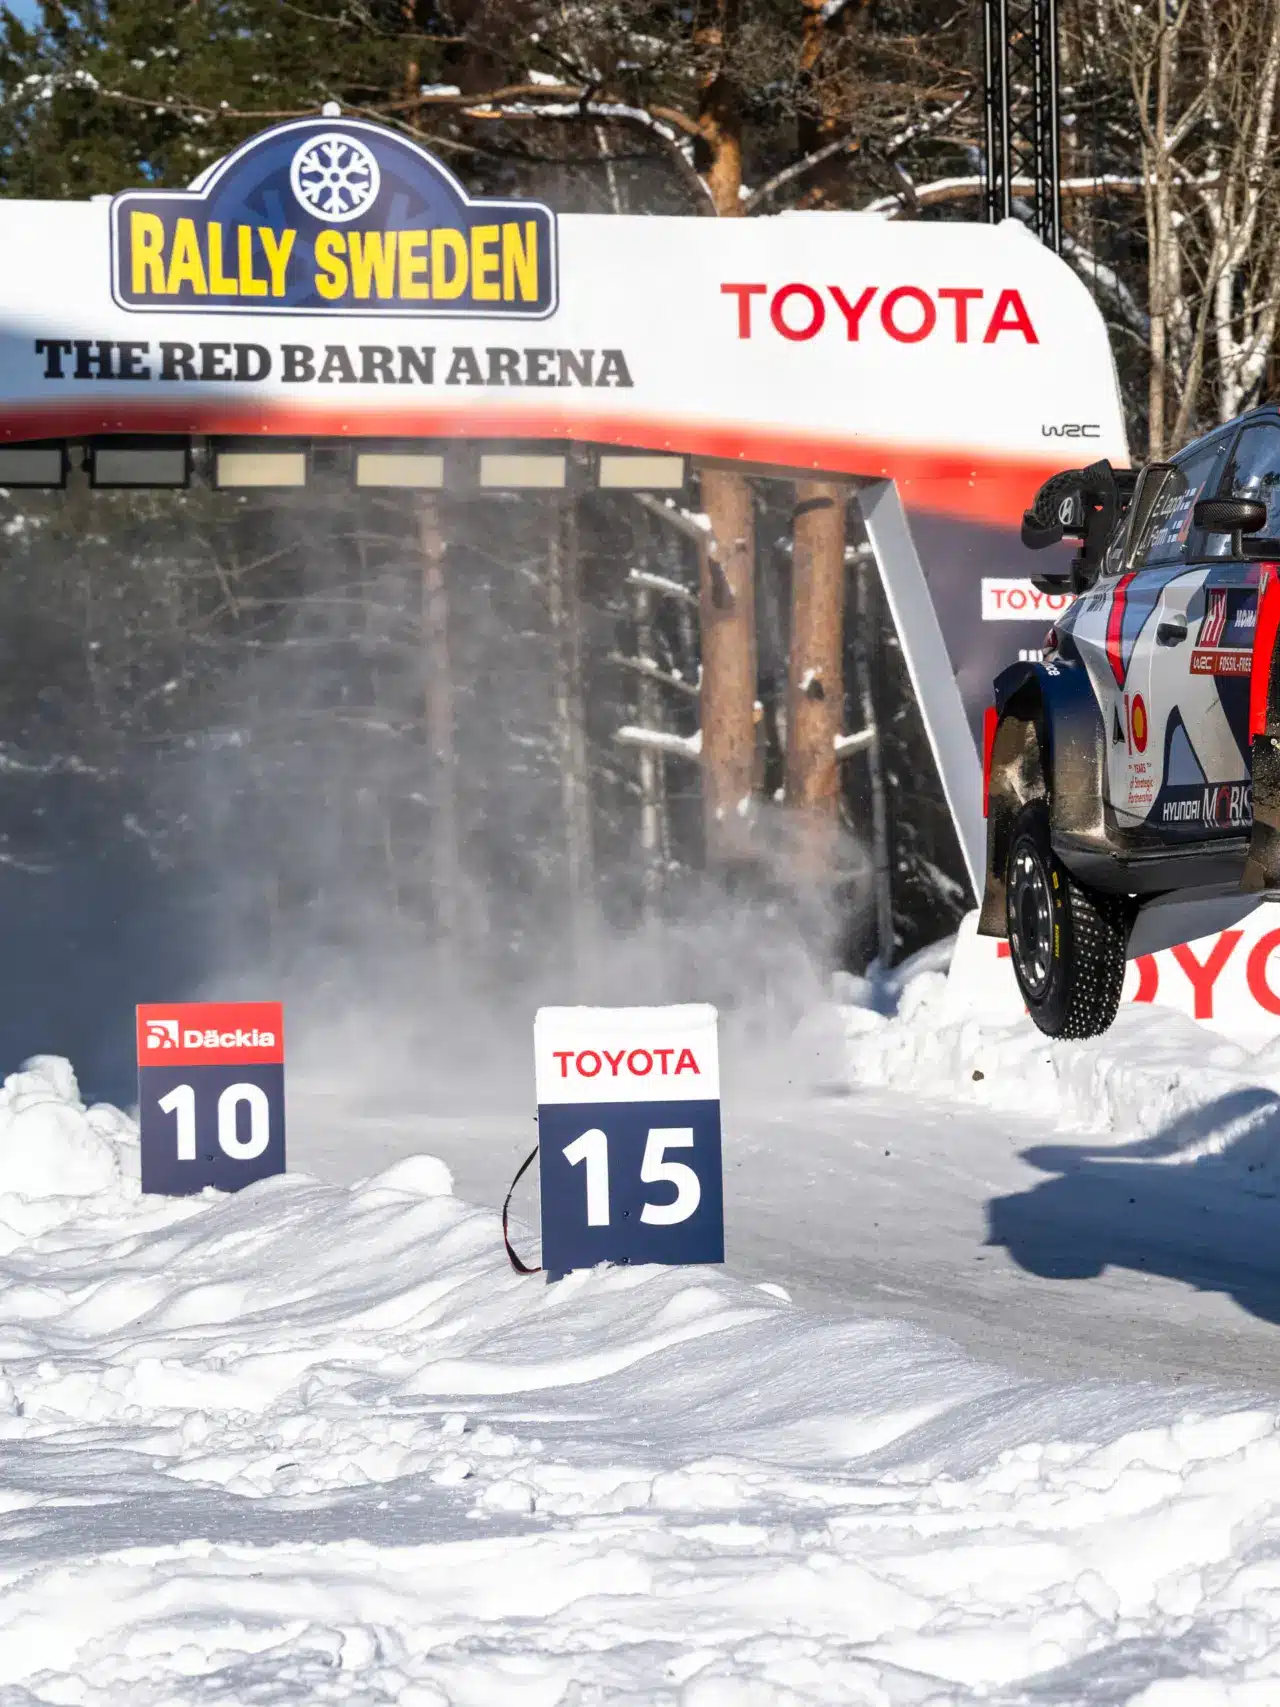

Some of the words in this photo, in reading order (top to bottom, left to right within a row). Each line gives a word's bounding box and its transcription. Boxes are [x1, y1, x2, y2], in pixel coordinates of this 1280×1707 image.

[130, 210, 297, 297] RALLY
[314, 220, 539, 302] SWEDEN
[719, 282, 1041, 345] TOYOTA
[35, 338, 150, 381] THE
[158, 341, 272, 383] RED
[281, 344, 436, 385] BARN
[445, 348, 634, 388] ARENA
[1041, 423, 1101, 439] WRC
[990, 588, 1078, 610] TOYO
[1192, 655, 1213, 670] WRC
[1162, 800, 1201, 822] HYUNDAI
[183, 1029, 276, 1049] Däckia
[553, 1048, 701, 1078] TOYOTA
[157, 1082, 270, 1161] 10
[561, 1127, 701, 1227] 15
